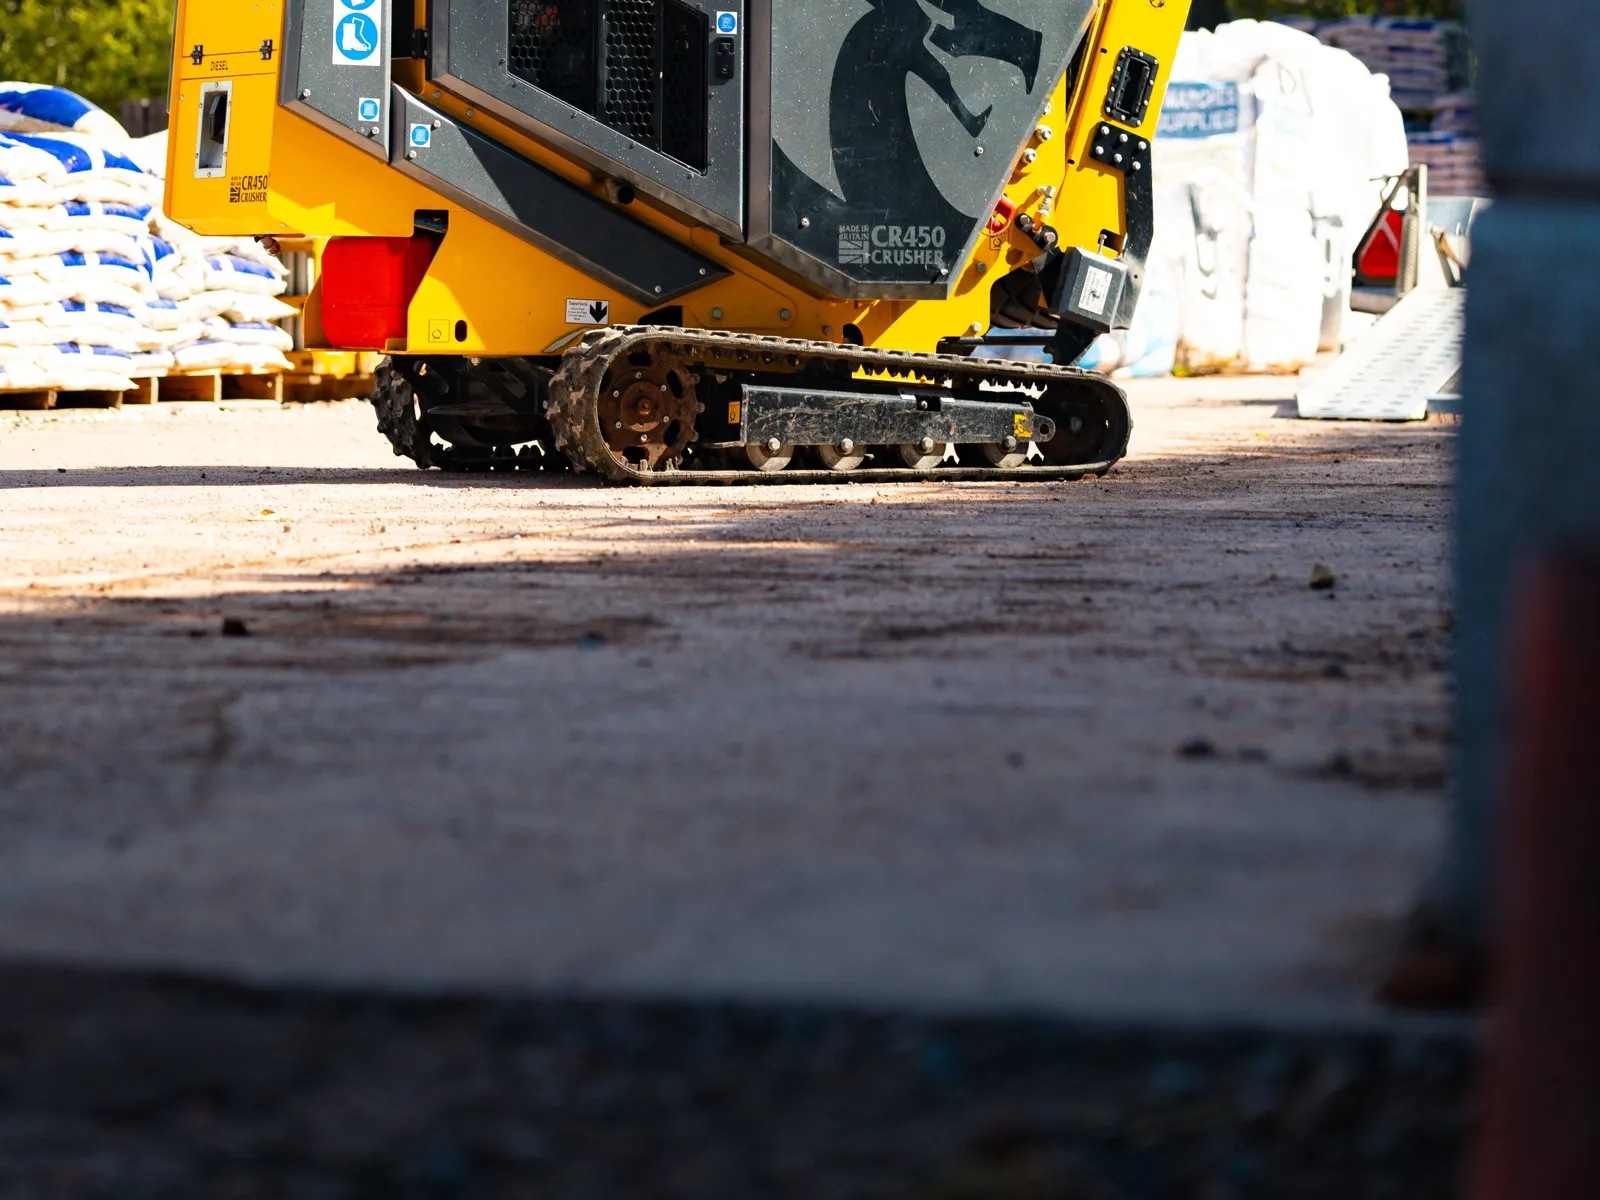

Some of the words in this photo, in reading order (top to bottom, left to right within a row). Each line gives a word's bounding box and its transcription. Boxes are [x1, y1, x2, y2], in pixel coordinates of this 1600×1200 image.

[210, 61, 228, 71] DIESEL
[242, 175, 268, 191] CR450
[241, 192, 267, 203] CRUSHER
[871, 225, 946, 248] CR450
[871, 250, 946, 265] CRUSHER
